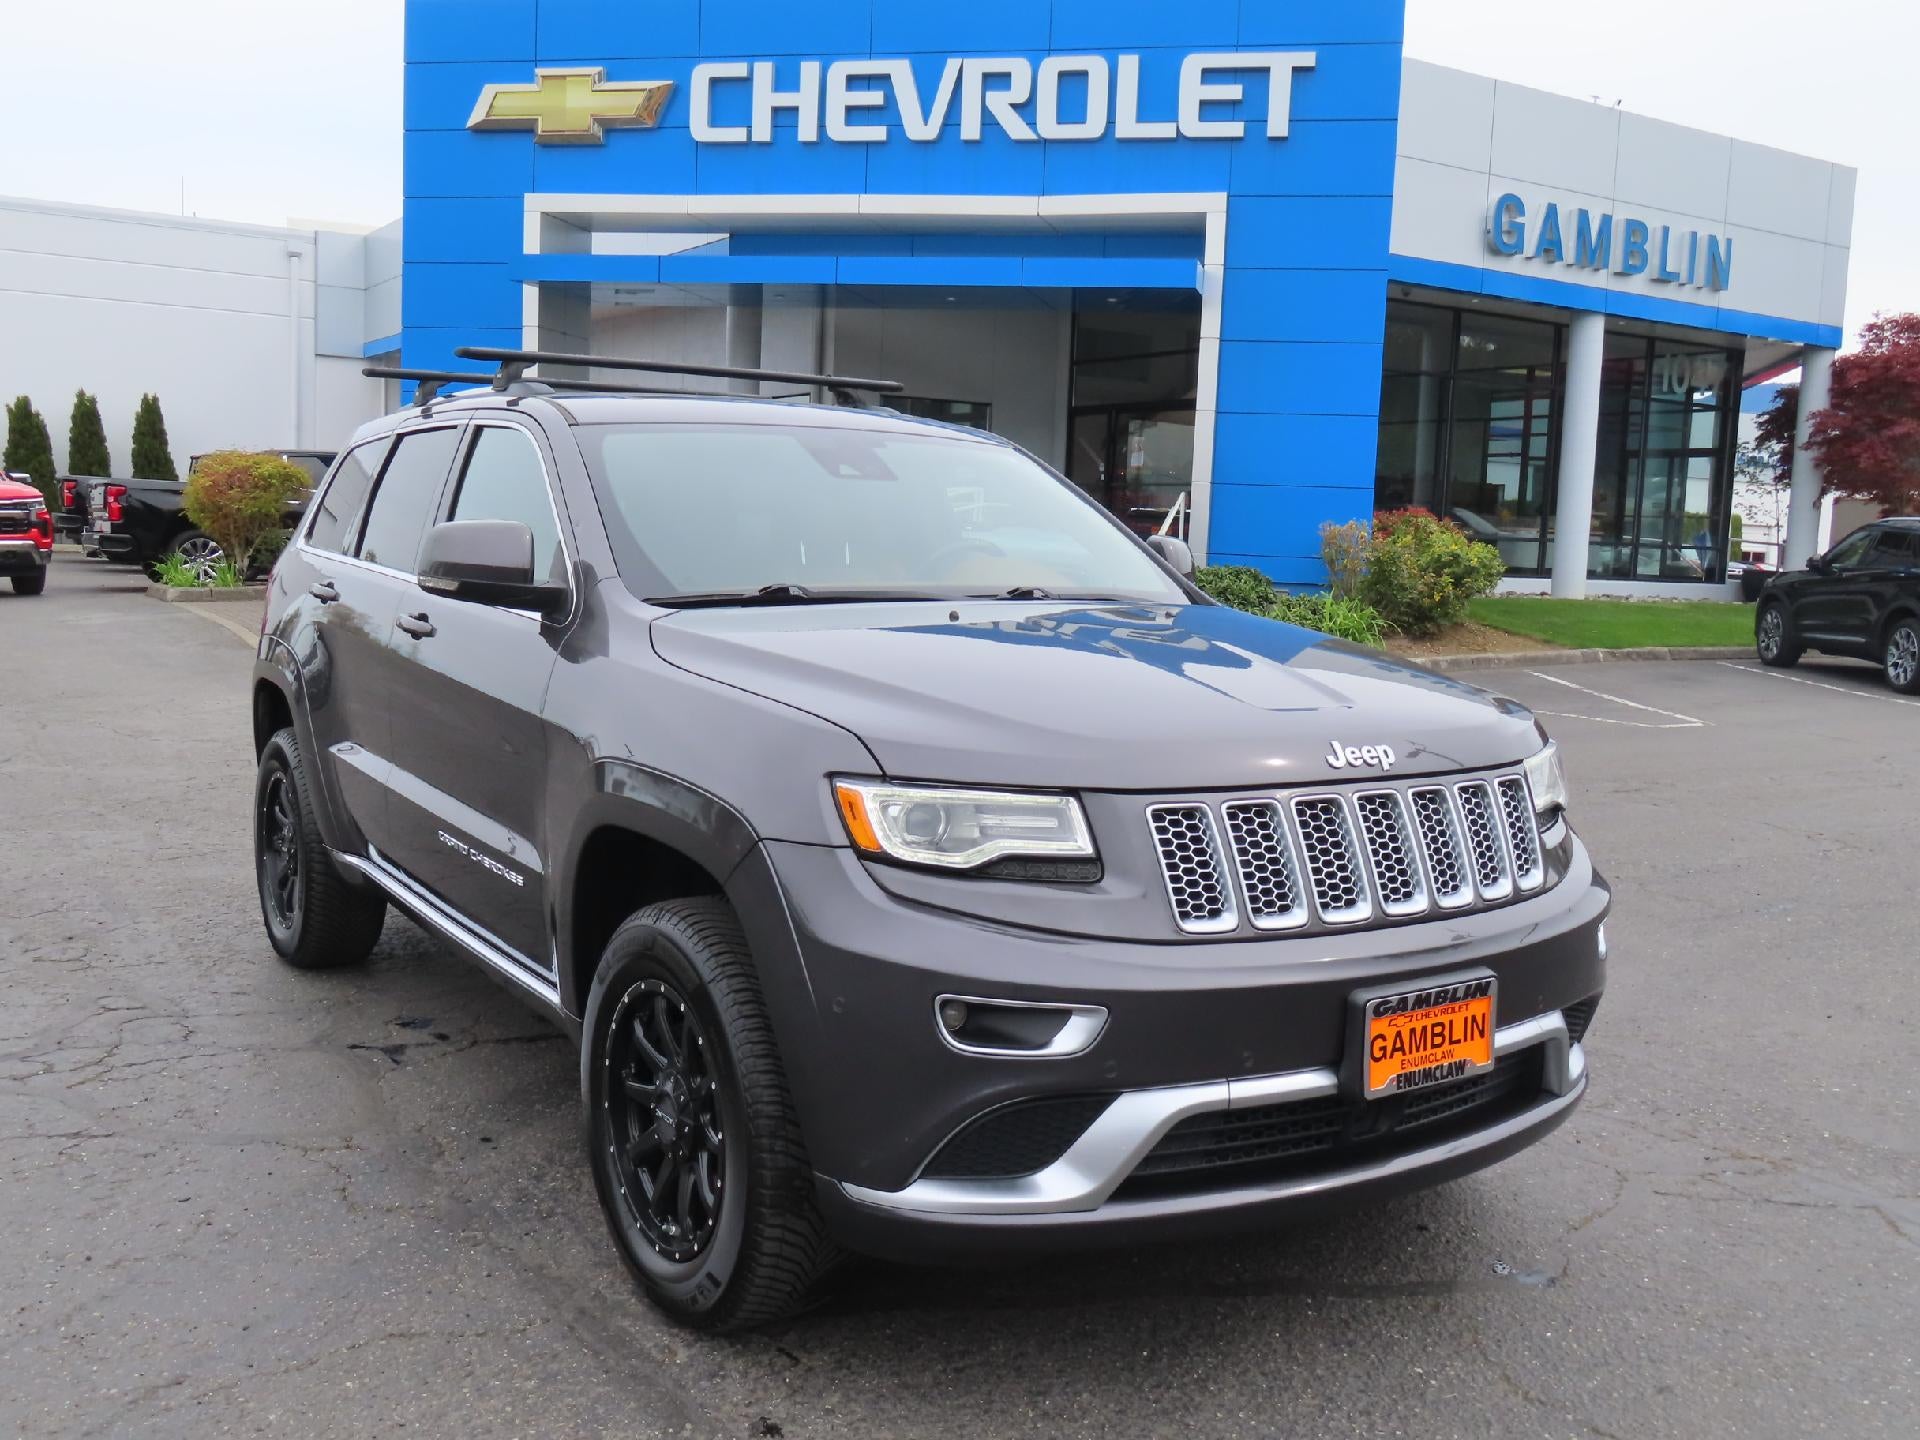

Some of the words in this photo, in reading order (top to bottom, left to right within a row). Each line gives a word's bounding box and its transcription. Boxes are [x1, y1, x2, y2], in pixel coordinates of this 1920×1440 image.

[689, 51, 1317, 144] CHEVROLET
[1489, 192, 1733, 292] GAMBLIN
[1325, 740, 1396, 771] Jeep
[1372, 981, 1492, 1018] GAMBLIN
[1415, 1003, 1471, 1021] CHEVROLET
[1370, 1012, 1486, 1063] GAMBLIN
[1396, 1059, 1467, 1091] ENUMCLAW
[1401, 1048, 1455, 1070] ENUMCLAW
